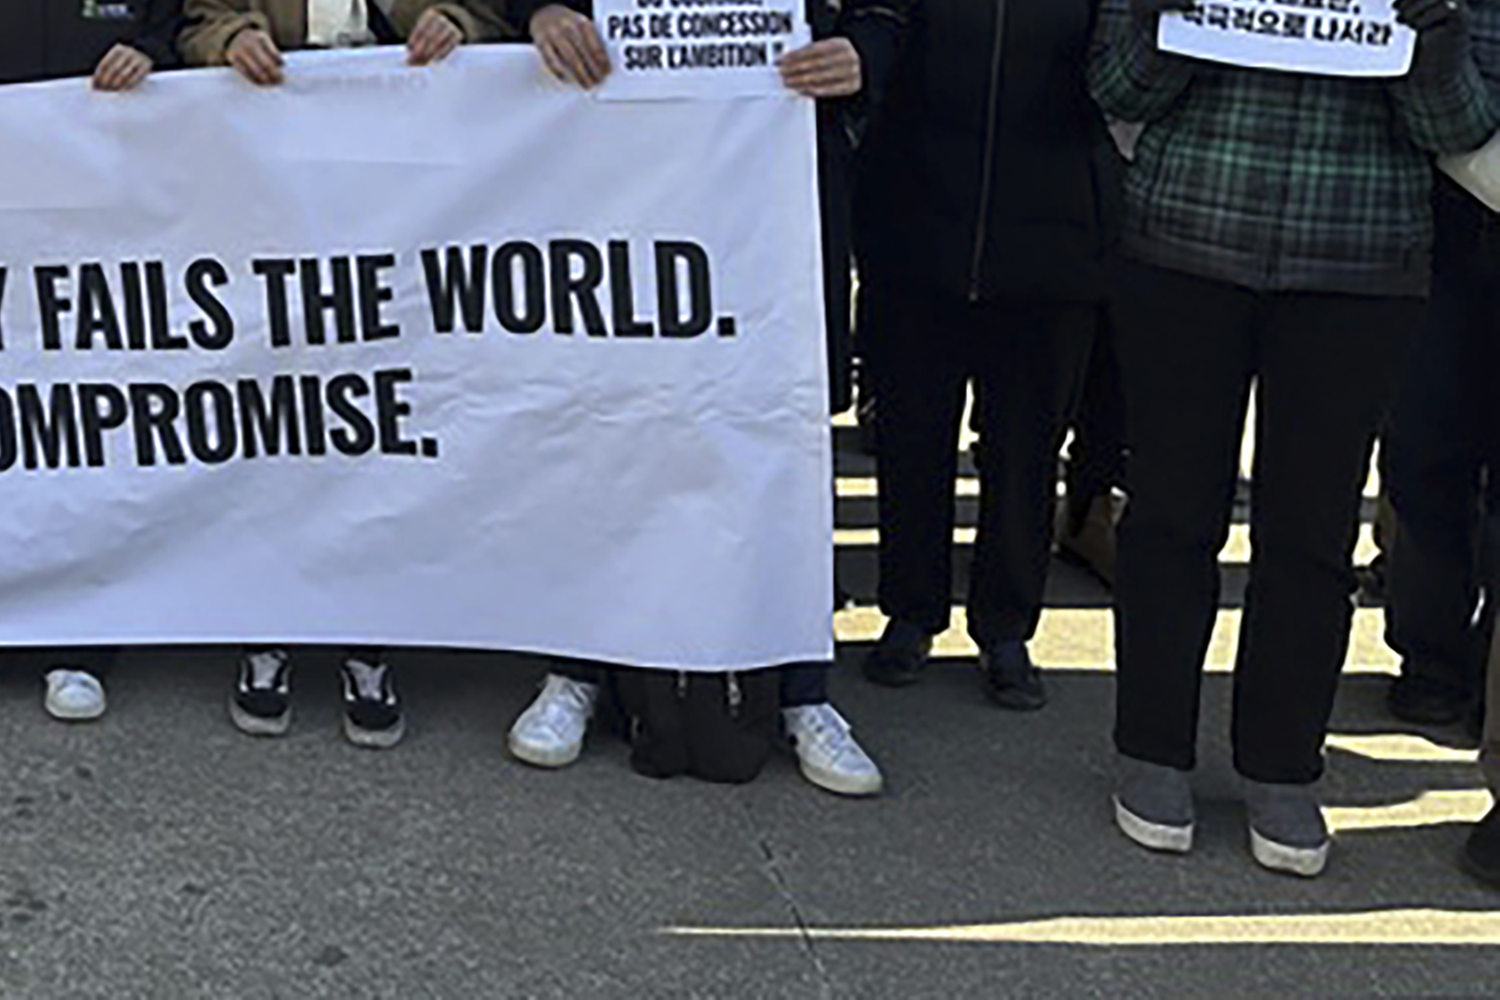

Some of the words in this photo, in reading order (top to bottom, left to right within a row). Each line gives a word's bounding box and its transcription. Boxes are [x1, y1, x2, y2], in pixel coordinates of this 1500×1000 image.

[607, 15, 645, 40] PAS
[650, 14, 673, 39] DE
[678, 11, 793, 38] CONCESSION
[1313, 18, 1393, 47] 나서라
[624, 45, 663, 70] SUR
[33, 258, 235, 351] FAILS
[251, 253, 401, 349] THE
[419, 238, 737, 339] WORLD.
